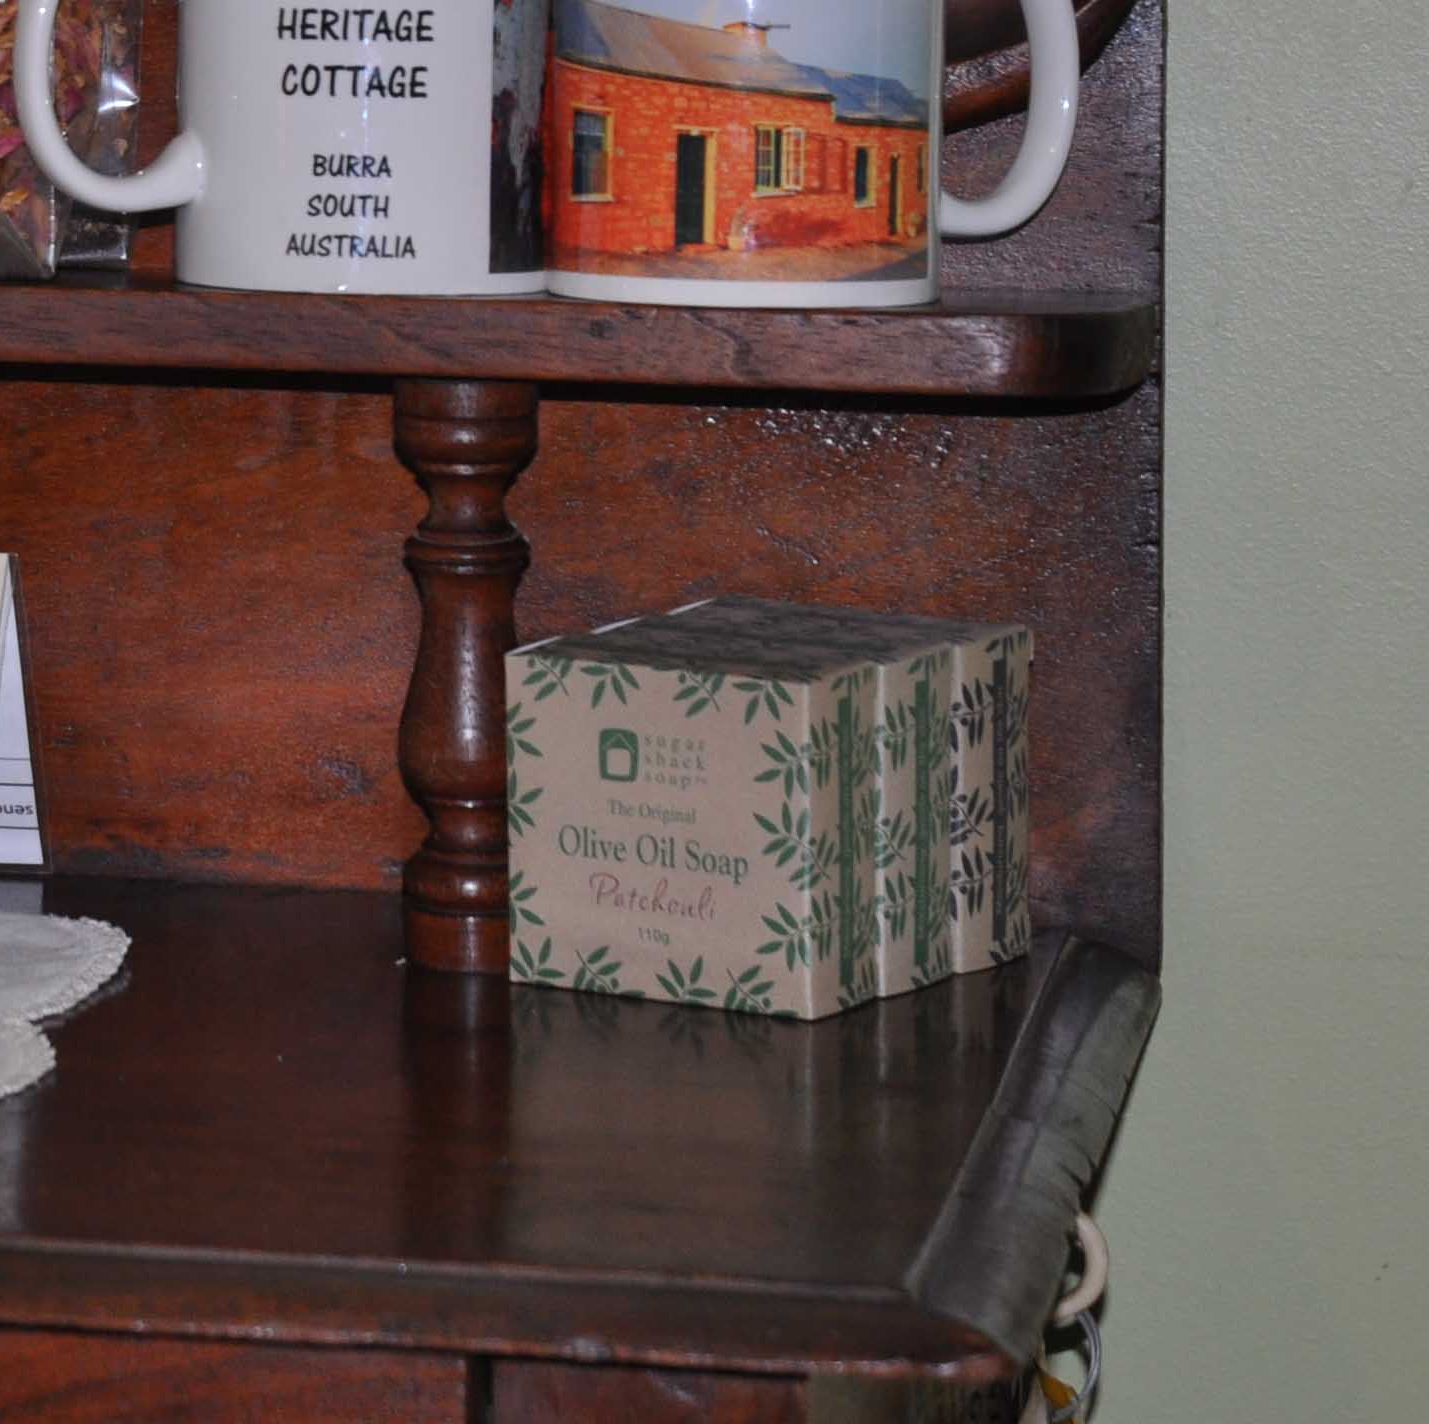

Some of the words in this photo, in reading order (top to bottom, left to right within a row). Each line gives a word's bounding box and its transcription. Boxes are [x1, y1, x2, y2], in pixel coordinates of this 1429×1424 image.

[276, 7, 435, 43] HERITAGE
[281, 64, 429, 99] COTTAGE
[312, 154, 392, 178] BURRA
[307, 194, 390, 219] SOUTH
[285, 233, 417, 259] AUSTRALIA
[609, 798, 633, 817] The
[638, 803, 696, 825] Original
[558, 824, 627, 864] Olive
[637, 832, 676, 869] Oil
[685, 839, 748, 886] Soap
[589, 872, 716, 921] Patchouli
